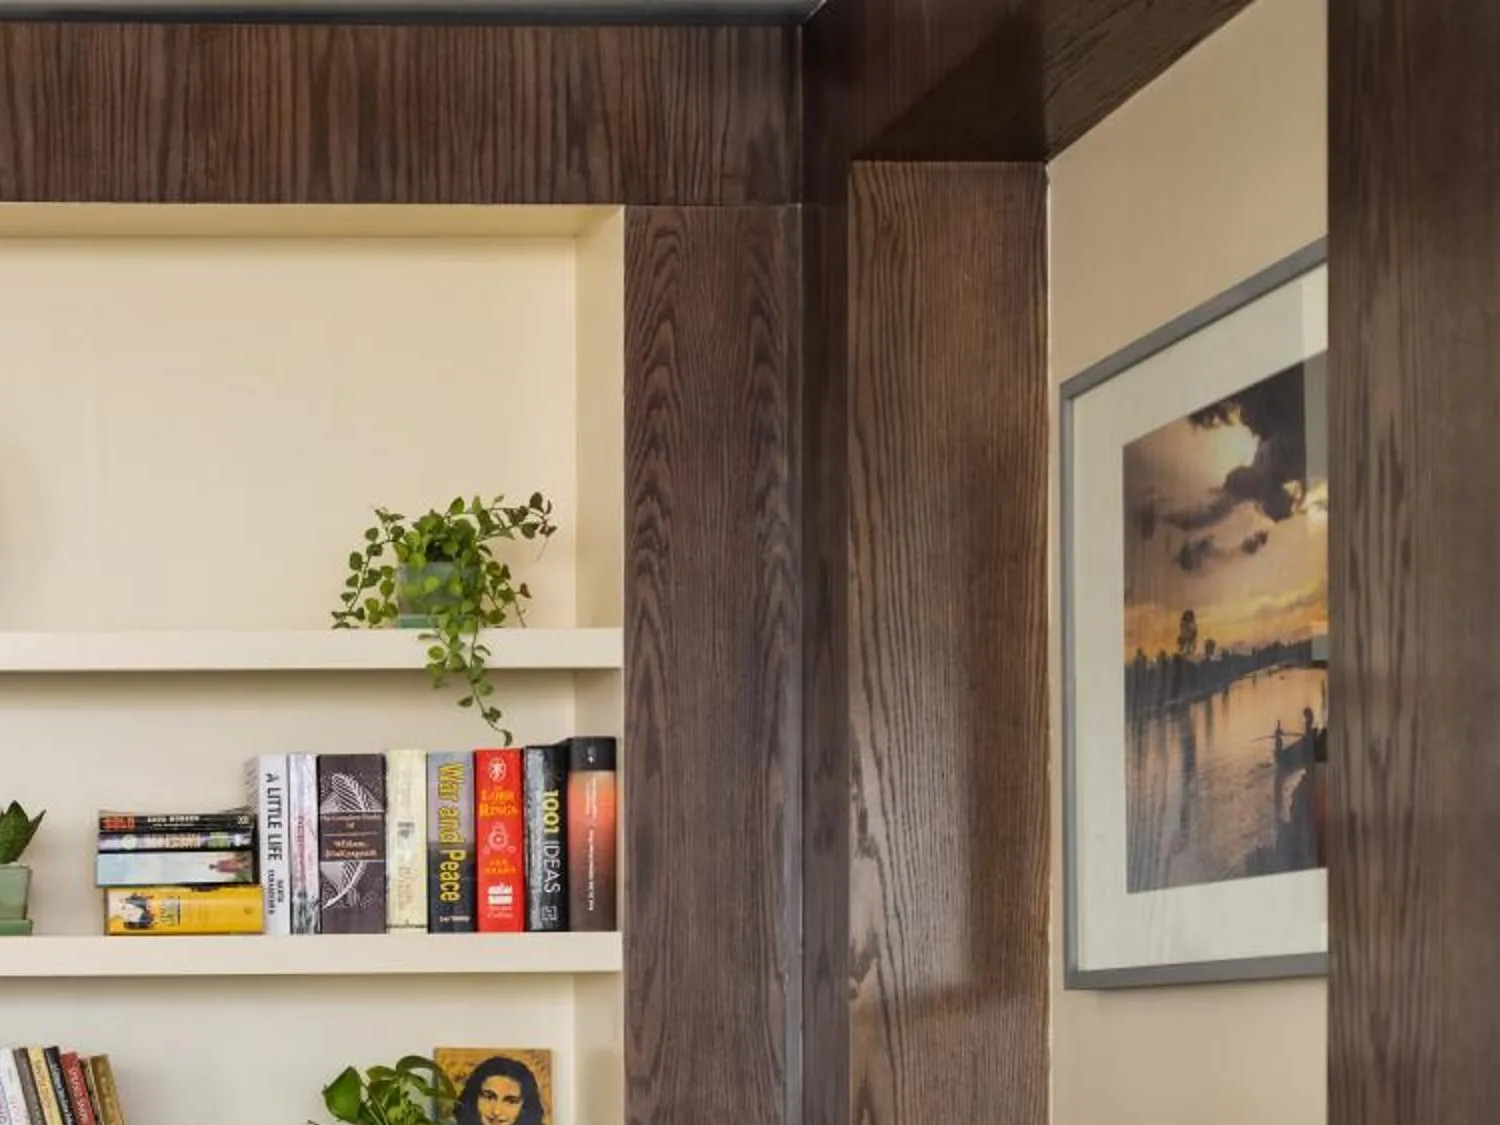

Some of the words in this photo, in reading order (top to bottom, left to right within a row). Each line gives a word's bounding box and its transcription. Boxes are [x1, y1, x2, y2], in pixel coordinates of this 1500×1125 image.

[267, 773, 278, 783] A
[438, 762, 466, 801] War
[267, 787, 282, 828] LITTLE
[438, 807, 467, 844] and
[543, 789, 560, 834] 1001
[267, 834, 282, 861] LIFE
[543, 840, 561, 894] IDEAS
[438, 848, 467, 903] Peace
